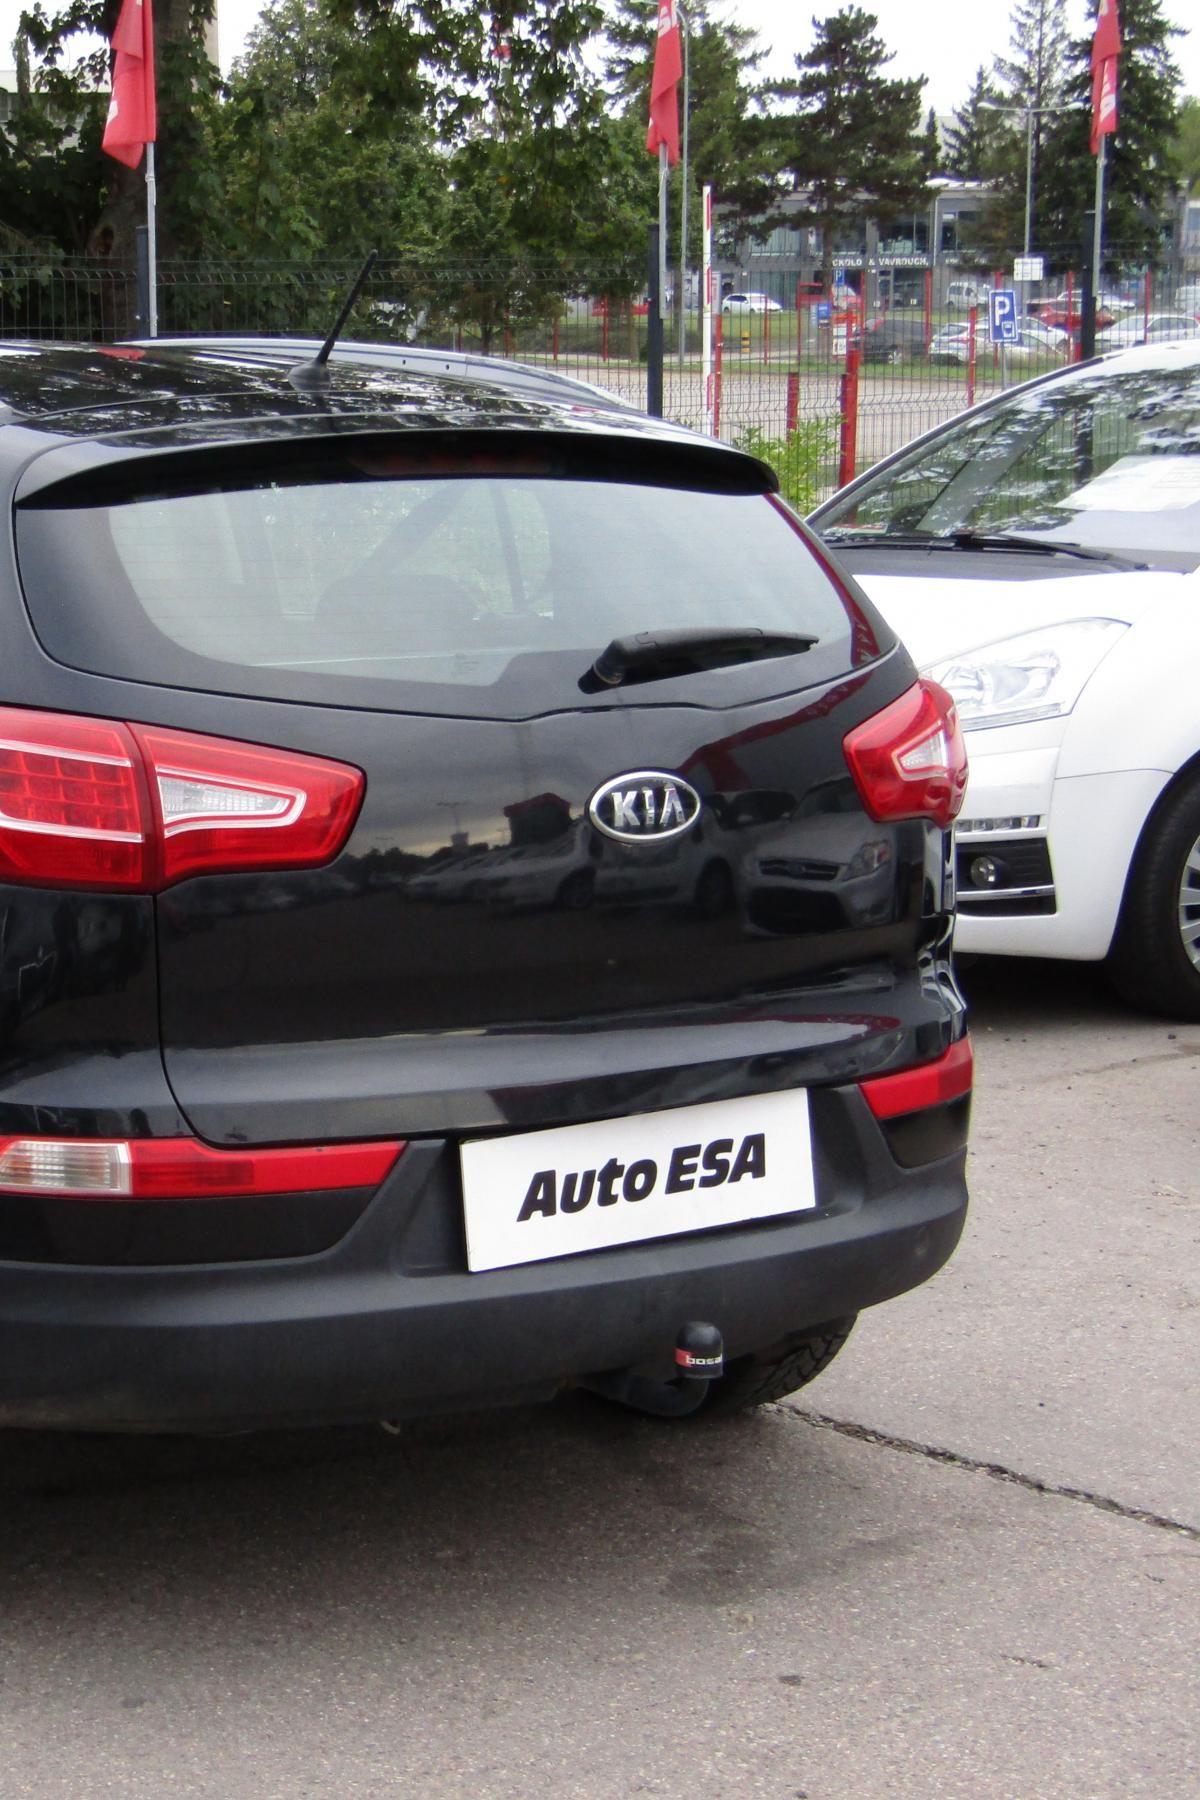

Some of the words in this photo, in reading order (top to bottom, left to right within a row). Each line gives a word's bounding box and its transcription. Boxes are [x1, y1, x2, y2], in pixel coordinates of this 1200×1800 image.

[994, 295, 1010, 326] P
[611, 783, 686, 828] KIA
[516, 1158, 658, 1222] Auto
[665, 1132, 766, 1195] ESA
